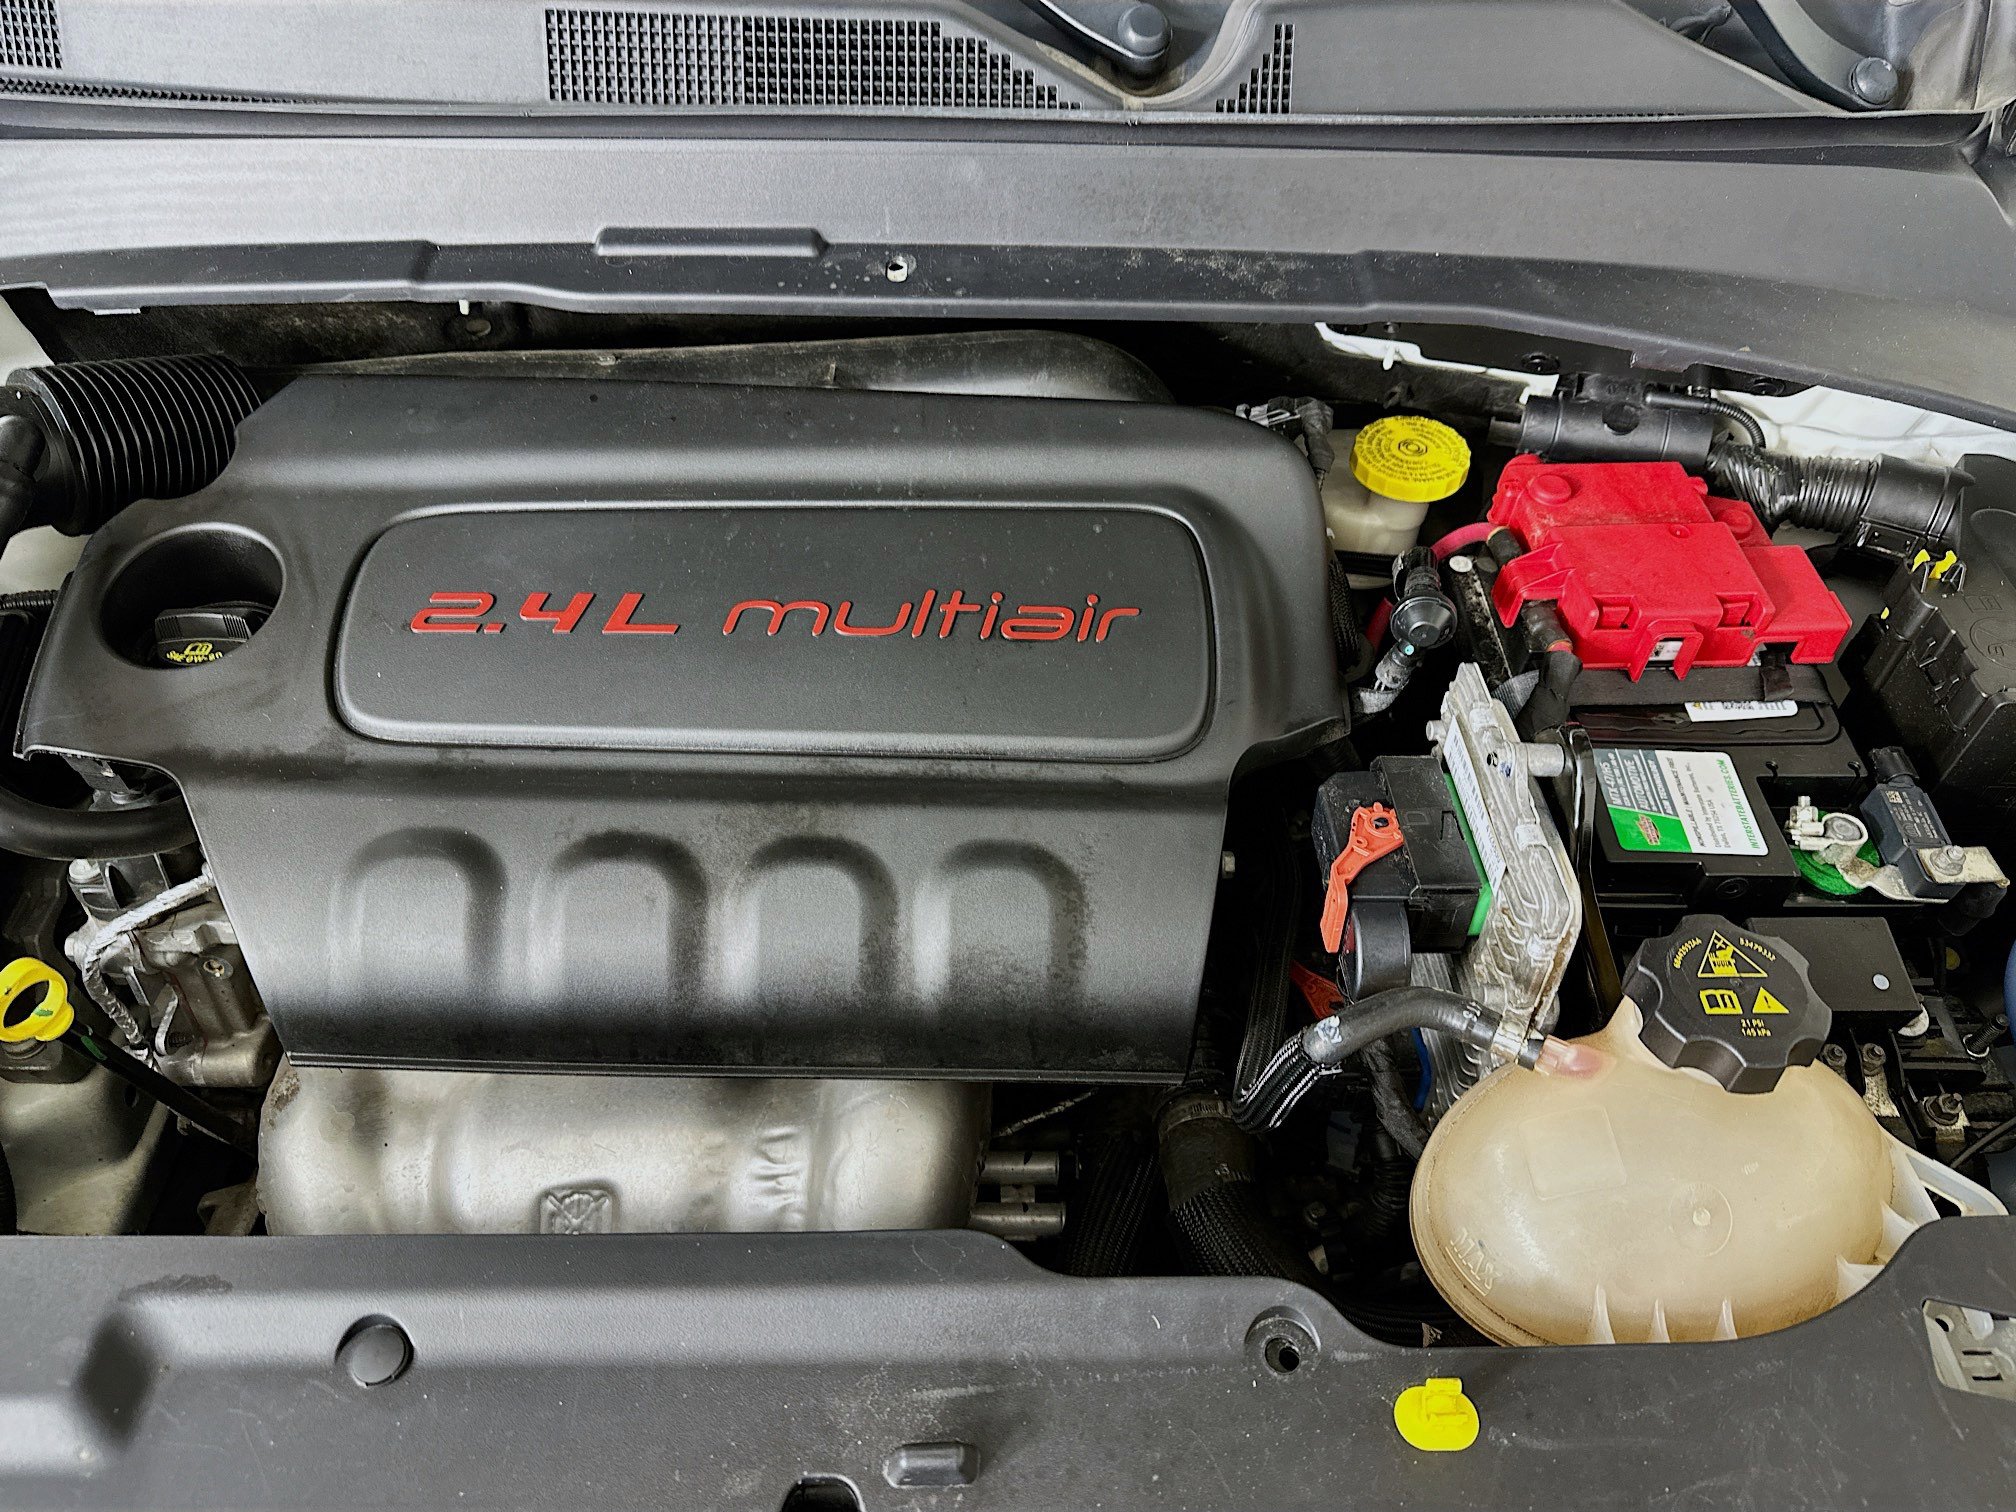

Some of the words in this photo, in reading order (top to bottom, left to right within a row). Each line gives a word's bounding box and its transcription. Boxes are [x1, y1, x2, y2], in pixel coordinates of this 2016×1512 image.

[723, 588, 1140, 642] multiair
[1623, 759, 1651, 811] AUTOMOTIVE
[1716, 759, 1760, 849] INTERSTATEBATTERIES.COM
[1450, 1227, 1503, 1290] MAX
